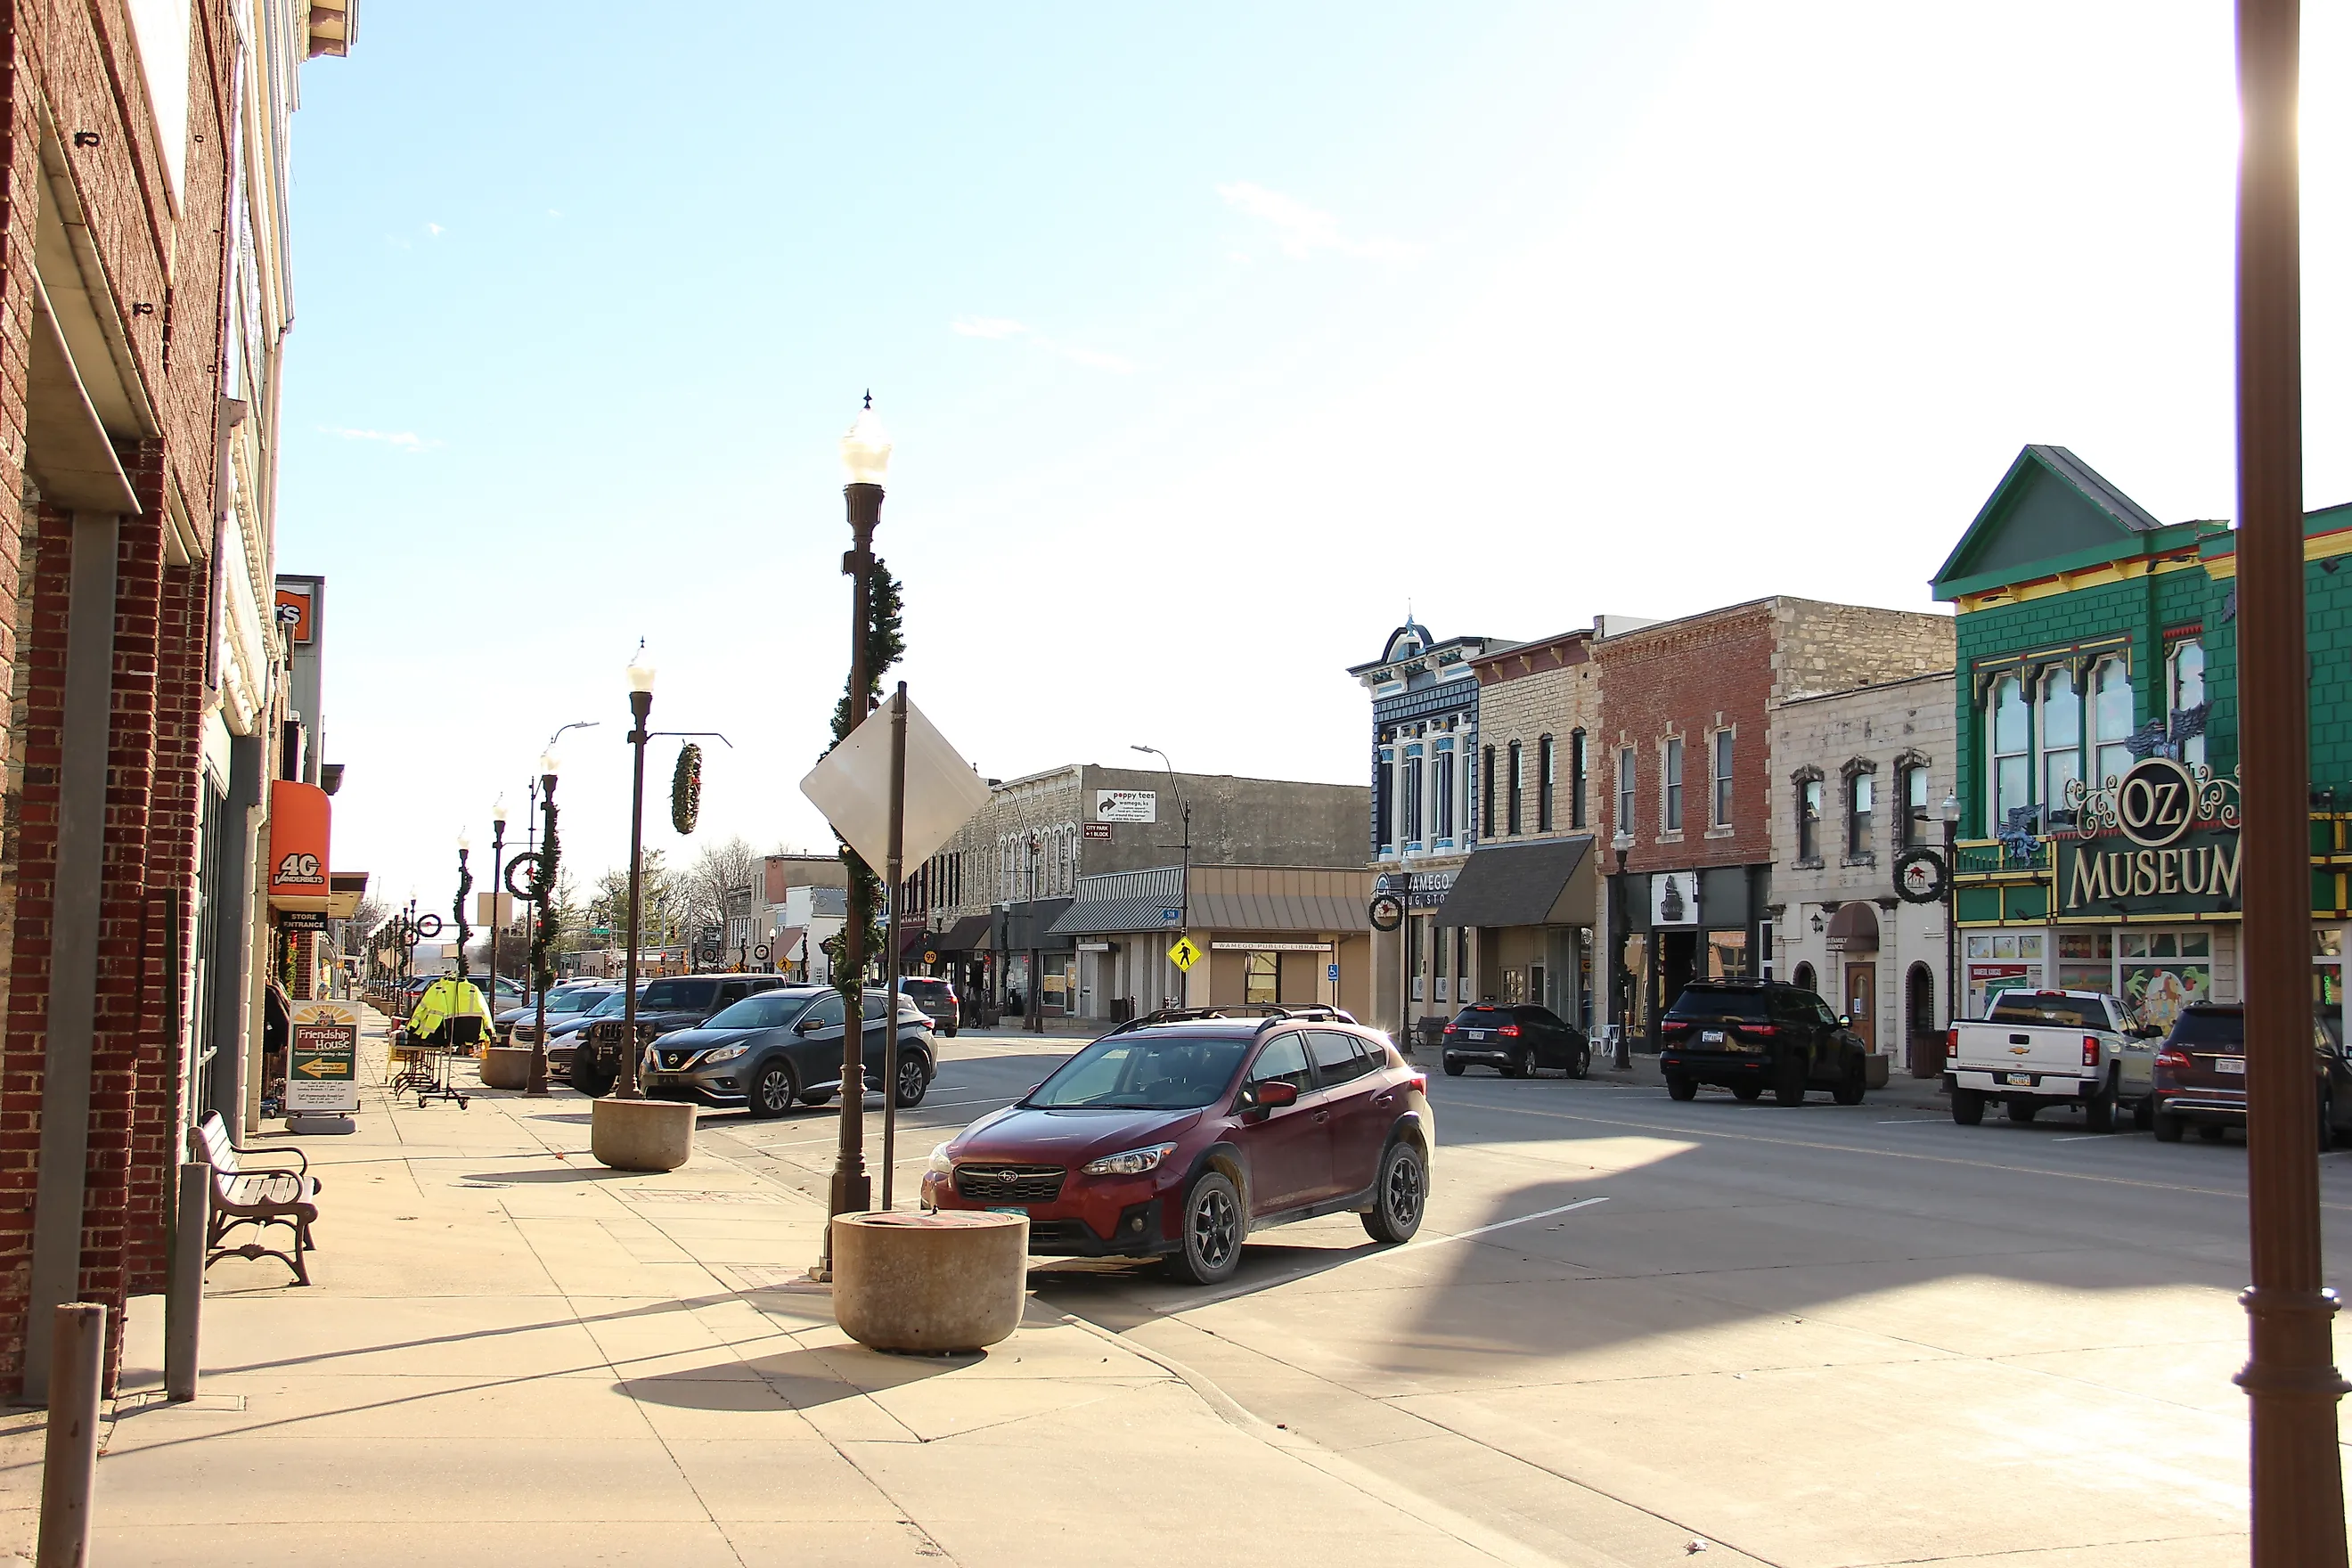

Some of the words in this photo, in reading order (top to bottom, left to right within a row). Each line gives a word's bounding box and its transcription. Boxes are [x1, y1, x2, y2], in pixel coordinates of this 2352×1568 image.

[274, 603, 300, 624] T'S
[1113, 792, 1137, 800] poppy
[2066, 835, 2242, 909] MUSEUM
[274, 872, 323, 885] VANDERBILT'S
[1426, 894, 1445, 904] STO
[926, 953, 935, 961] 99
[298, 1029, 350, 1041] Friendship
[315, 1040, 351, 1050] House
